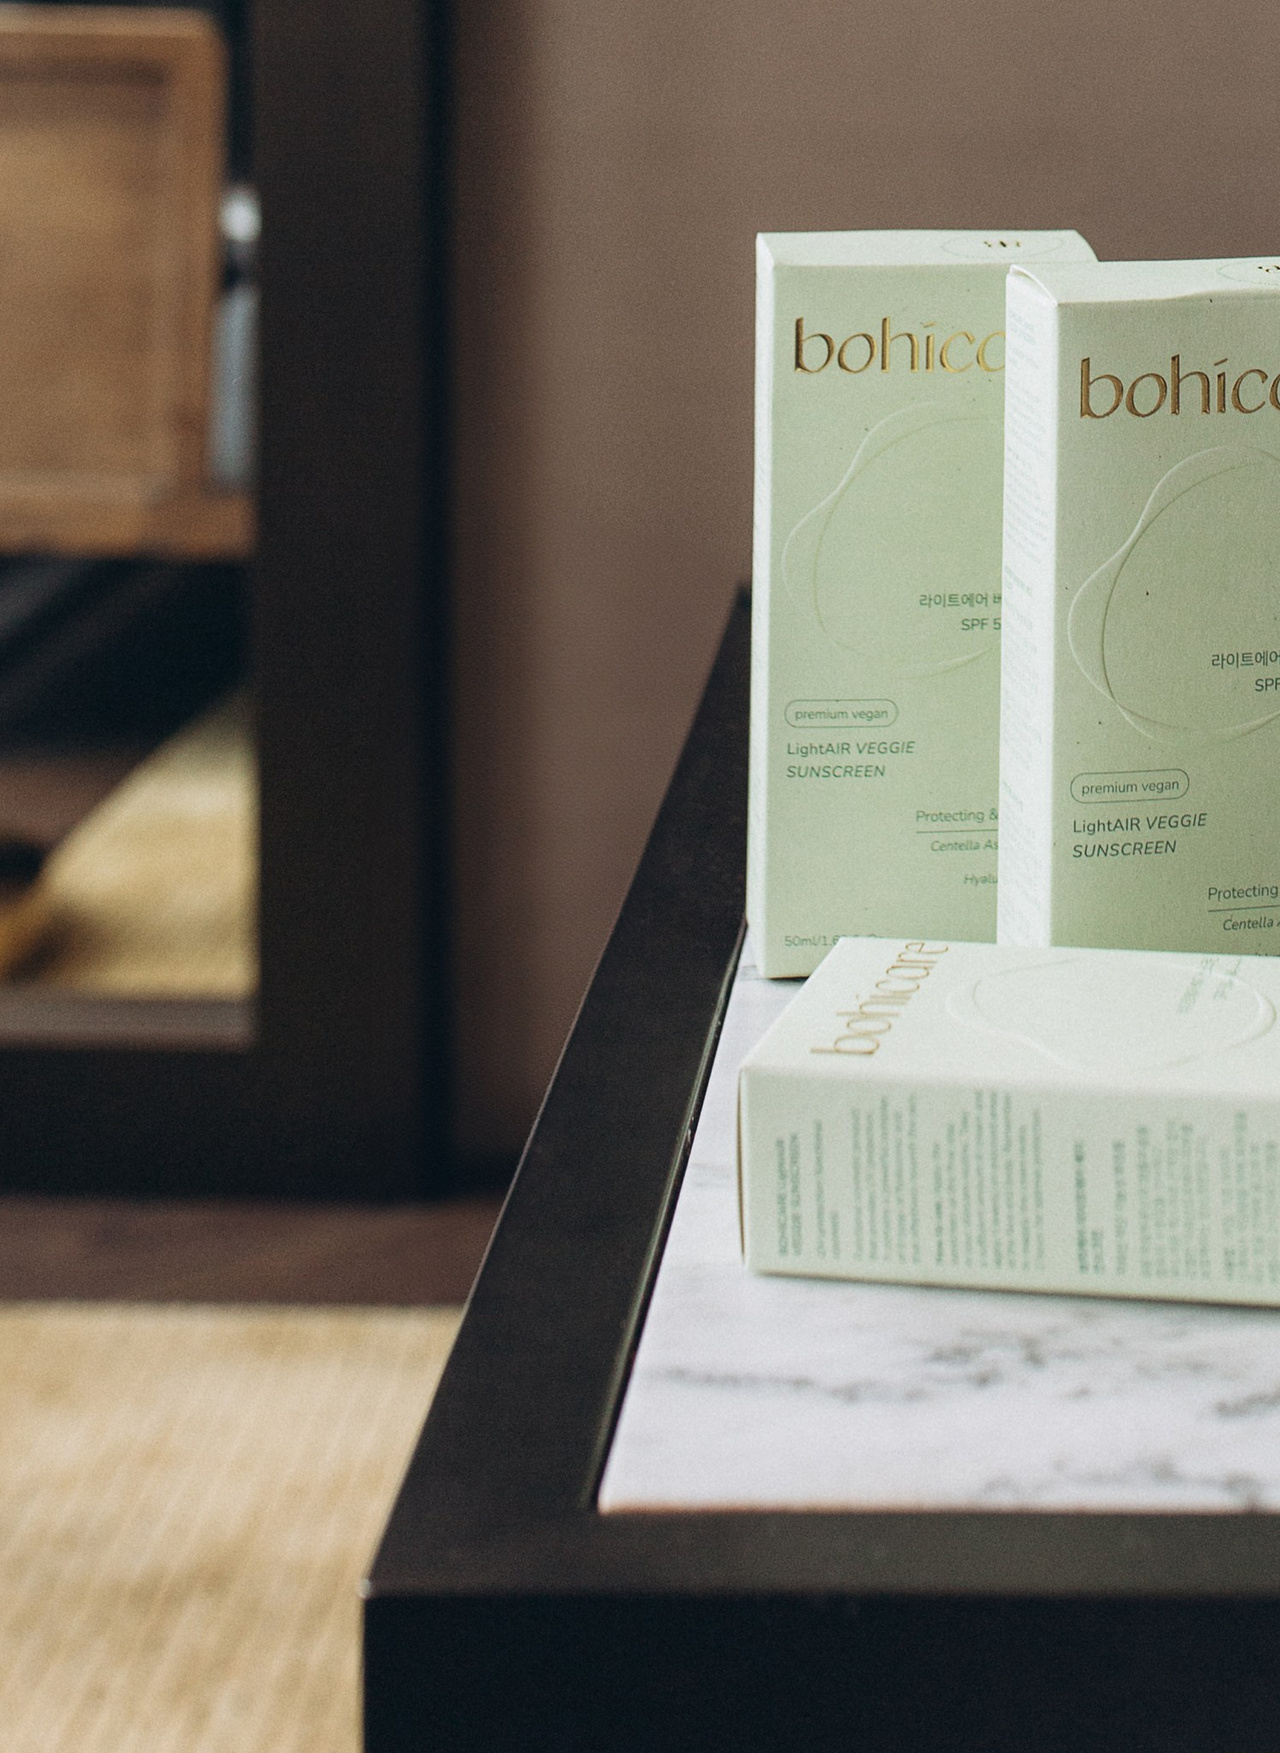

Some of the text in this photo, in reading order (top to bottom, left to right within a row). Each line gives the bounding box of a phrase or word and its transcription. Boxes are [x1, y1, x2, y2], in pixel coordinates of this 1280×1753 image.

[919, 593, 988, 608] 라이트에어
[961, 618, 988, 631] SPF
[795, 709, 889, 722] premium vegan
[787, 741, 916, 758] LightAIR VEGGIE
[786, 765, 886, 778] SUNSCREEN
[1081, 780, 1180, 797] premium vegan
[916, 810, 985, 823] Protecting
[1073, 812, 1208, 836] LightAIR VEGGIE
[930, 840, 980, 852] Centella
[1072, 840, 1177, 858] SUNSCREEN
[963, 873, 998, 887] Hyalu
[1208, 884, 1279, 902] Protecting
[1223, 916, 1274, 931] Centella
[784, 935, 847, 947] 50ml/1.6
